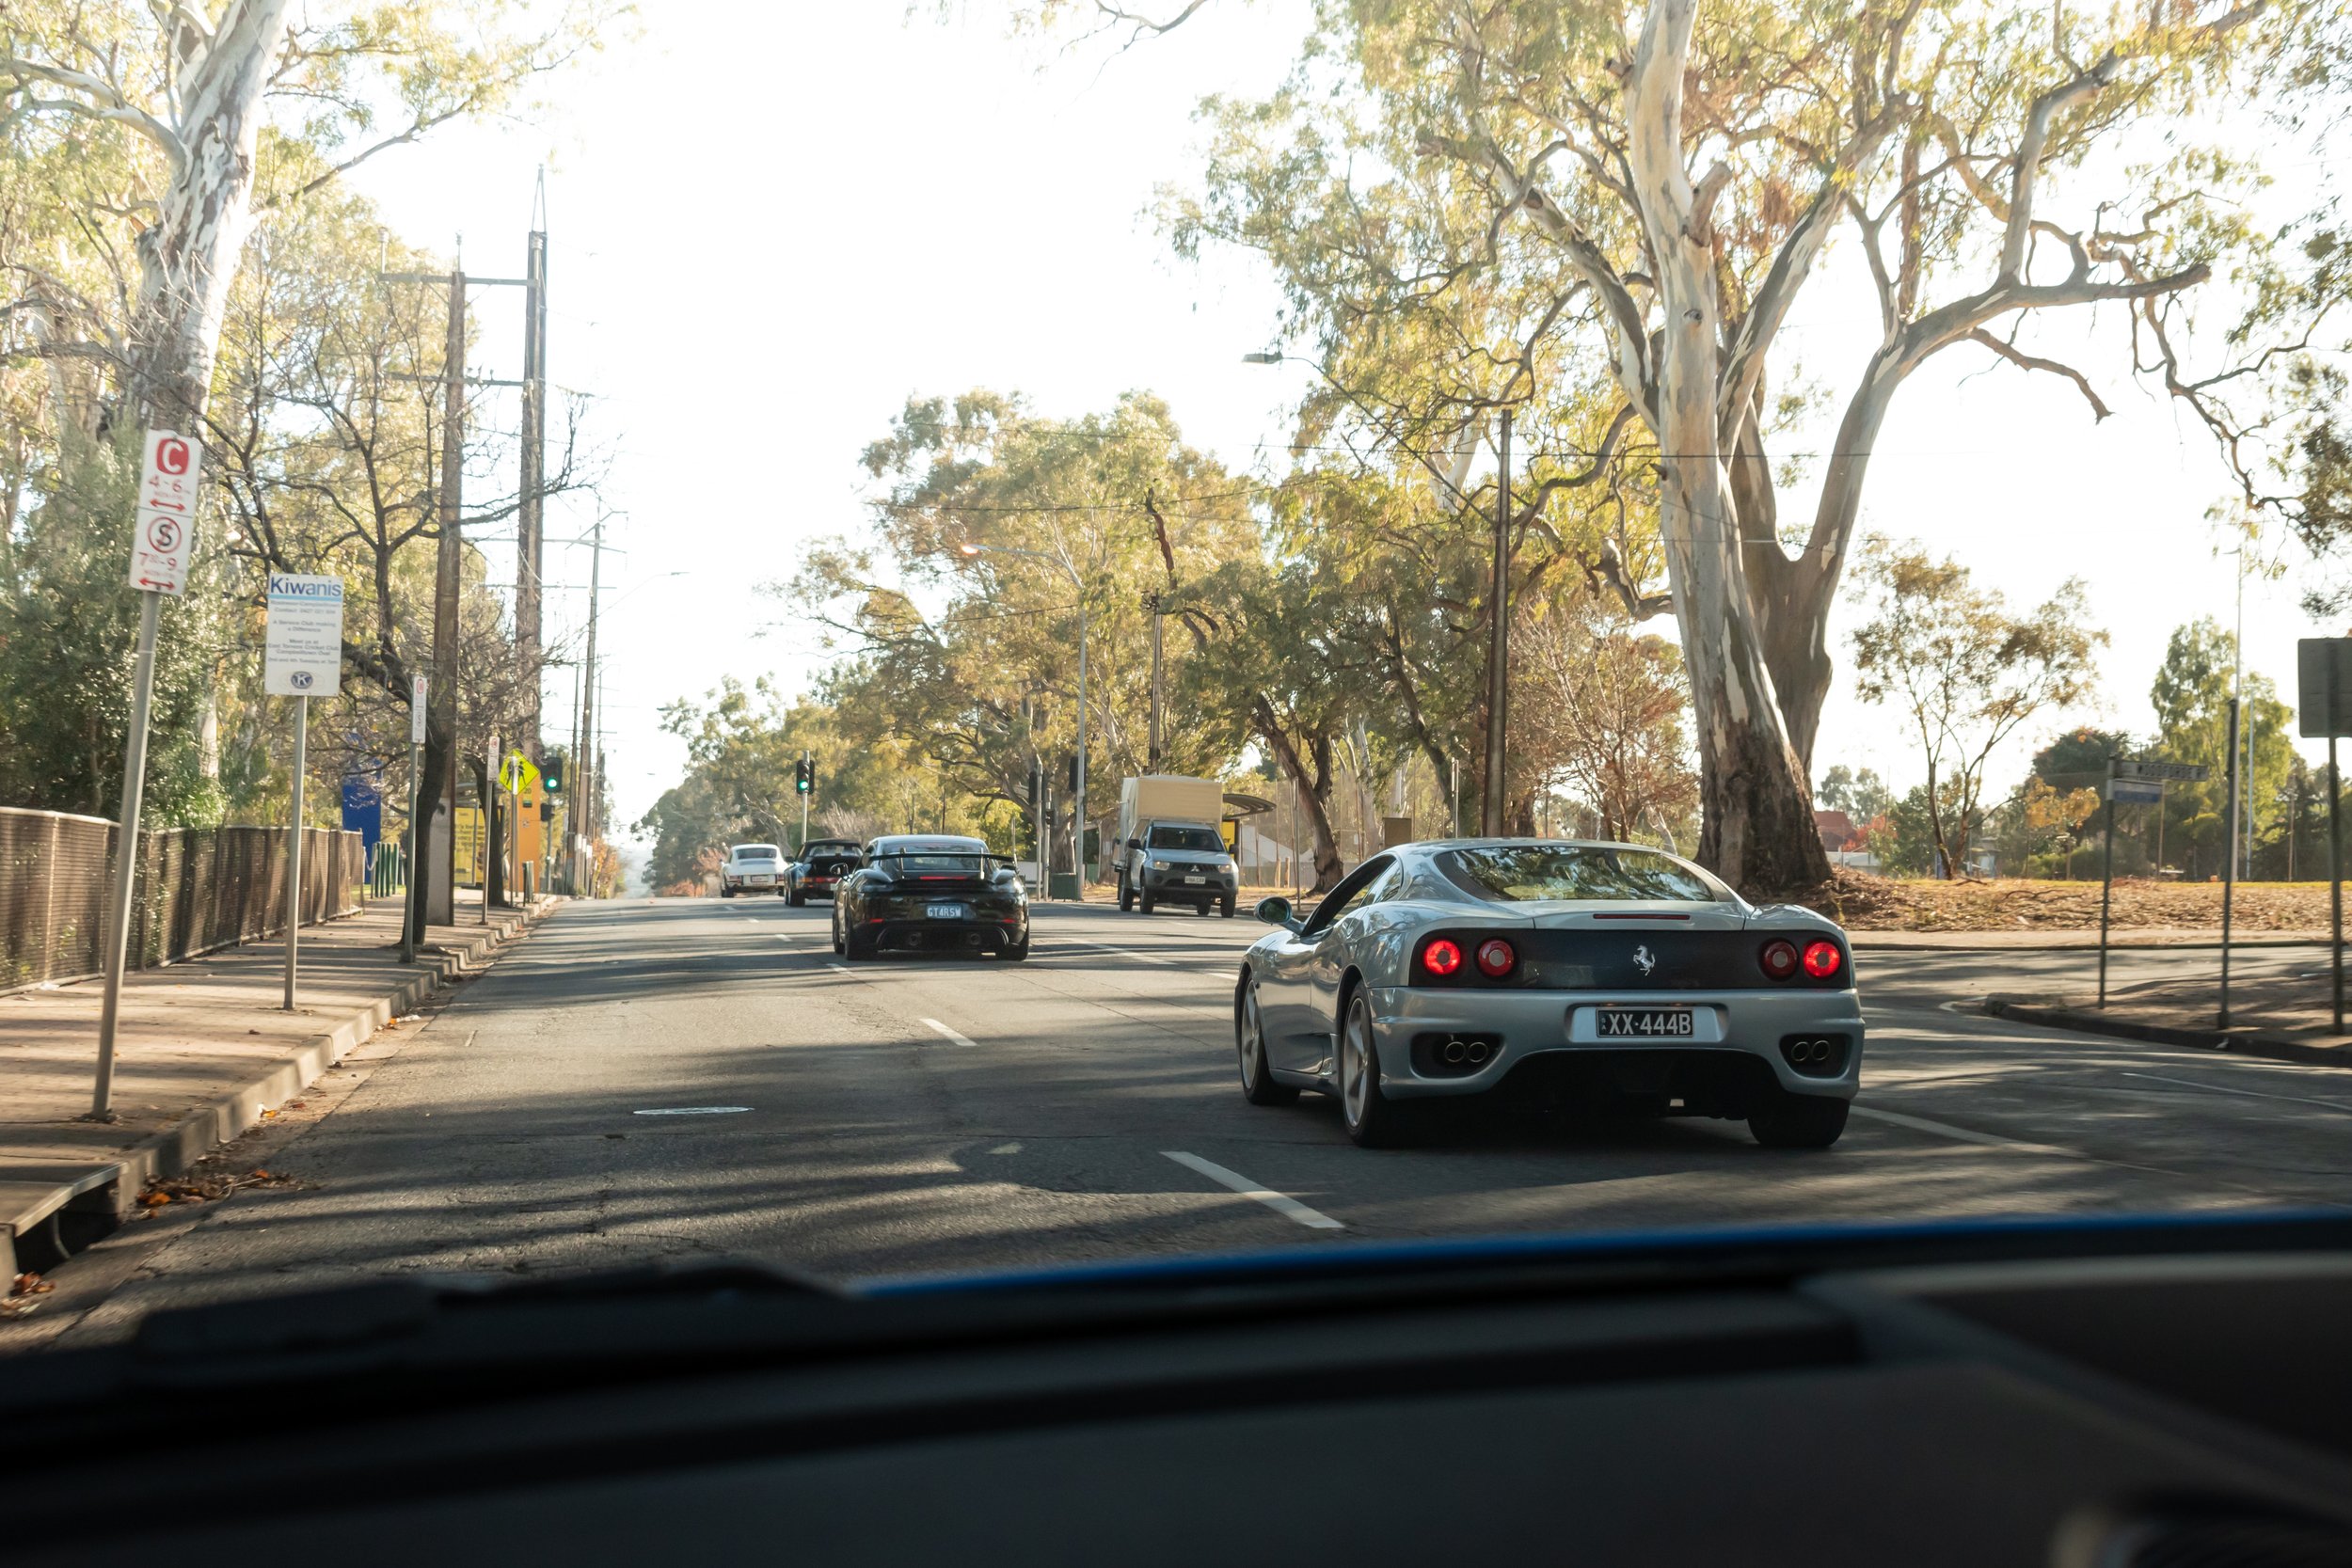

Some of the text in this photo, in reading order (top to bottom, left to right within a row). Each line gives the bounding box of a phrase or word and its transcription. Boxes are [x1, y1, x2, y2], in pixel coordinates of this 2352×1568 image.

[162, 441, 184, 473] C
[156, 524, 172, 546] S
[270, 577, 342, 596] Kiwanis
